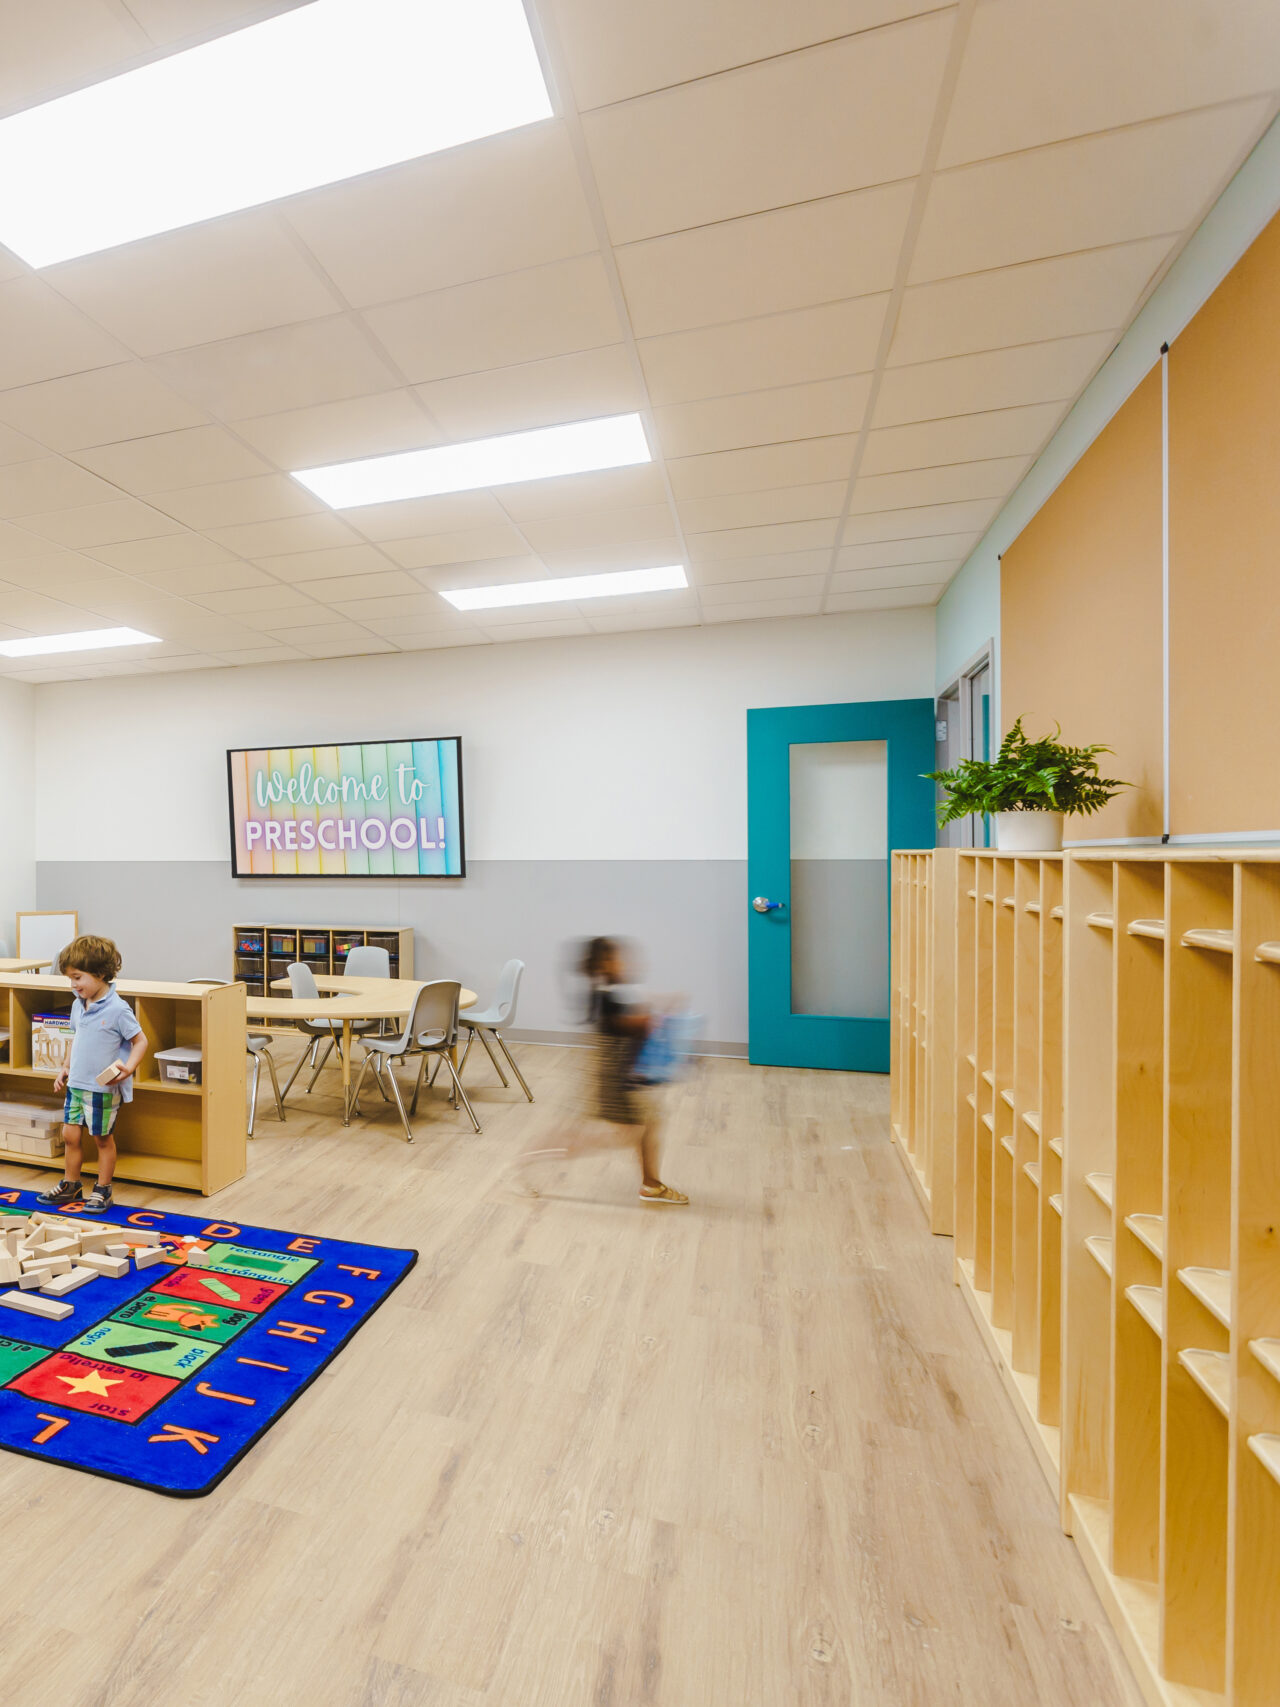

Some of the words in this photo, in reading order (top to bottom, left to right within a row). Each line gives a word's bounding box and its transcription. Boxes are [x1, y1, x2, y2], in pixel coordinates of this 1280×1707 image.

[256, 763, 389, 807] Welcome
[395, 763, 432, 805] to
[246, 817, 446, 851] PRESCHOOL!
[58, 1201, 86, 1213] B
[127, 1212, 166, 1226] C
[200, 1222, 241, 1238] D
[287, 1236, 322, 1253] E
[229, 1246, 300, 1263] rectangle
[207, 1264, 294, 1284] rectángulo
[337, 1263, 381, 1280] F
[303, 1290, 354, 1309] G
[222, 1313, 250, 1326] dog
[80, 1326, 113, 1346] negro
[266, 1320, 326, 1344] H
[11, 1343, 33, 1353] el
[58, 1353, 127, 1377] estrella
[174, 1348, 207, 1369] black
[128, 1371, 150, 1382] la
[195, 1382, 257, 1406] J
[87, 1402, 130, 1417] star
[31, 1412, 71, 1445] L
[147, 1423, 220, 1456] K
